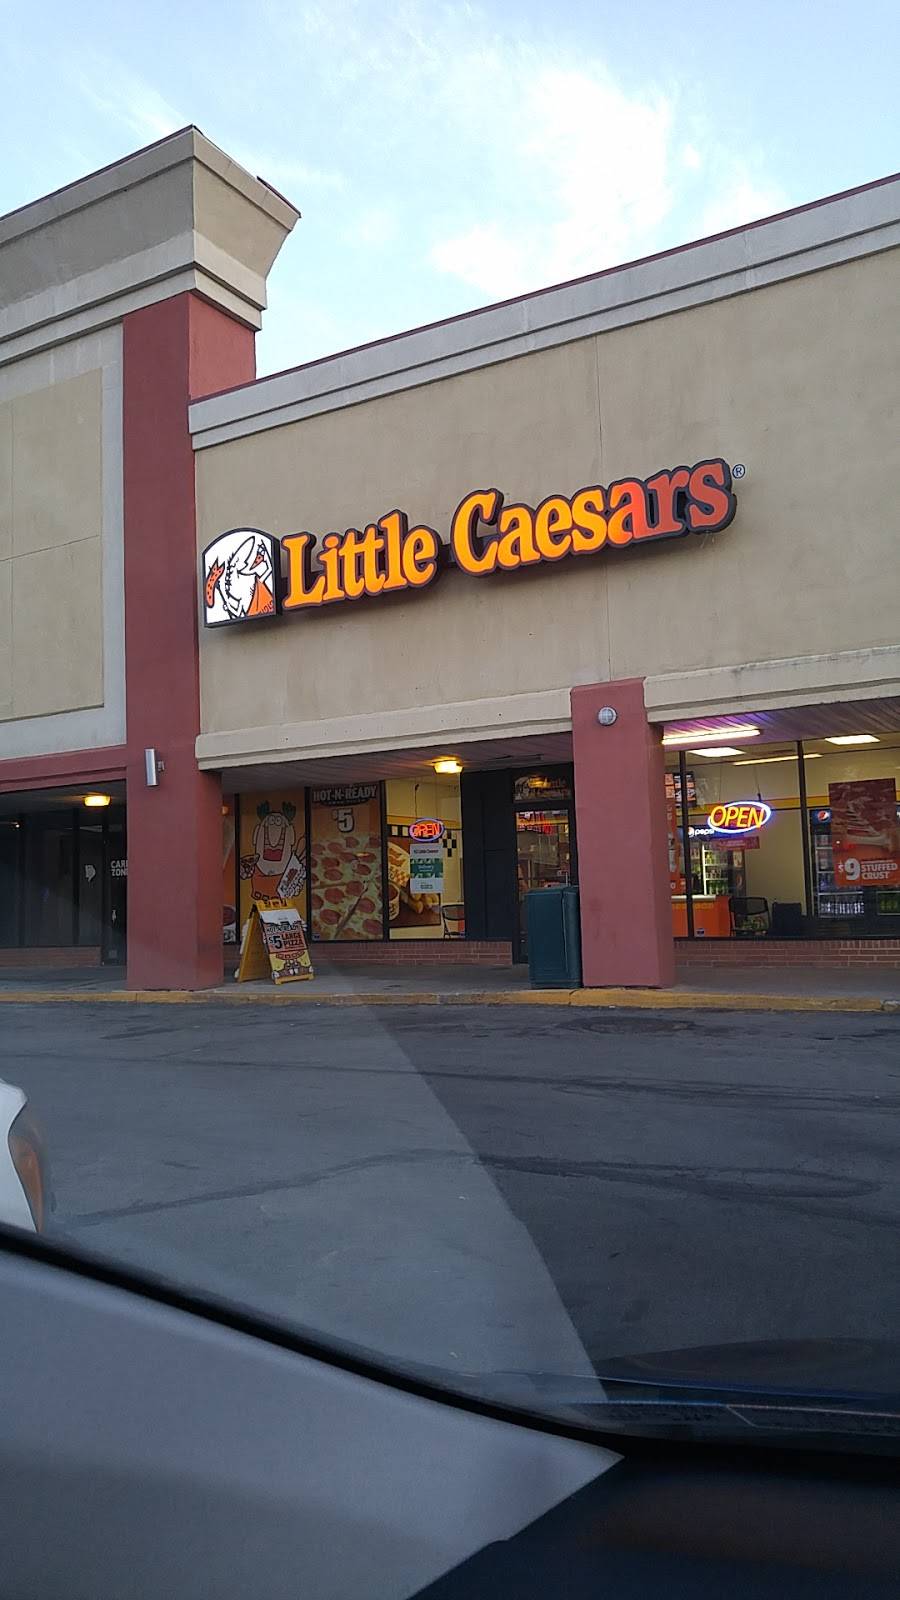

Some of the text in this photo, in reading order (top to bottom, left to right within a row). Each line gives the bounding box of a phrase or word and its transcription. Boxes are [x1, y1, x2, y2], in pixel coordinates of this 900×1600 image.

[281, 511, 440, 610] Little
[451, 460, 732, 576] Caesars
[313, 785, 377, 802] HOT-N-READY
[710, 805, 765, 829] OPEN
[413, 823, 440, 838] OPEN
[838, 857, 898, 881] $9 STUFFED
[282, 939, 304, 947] PIZZA
